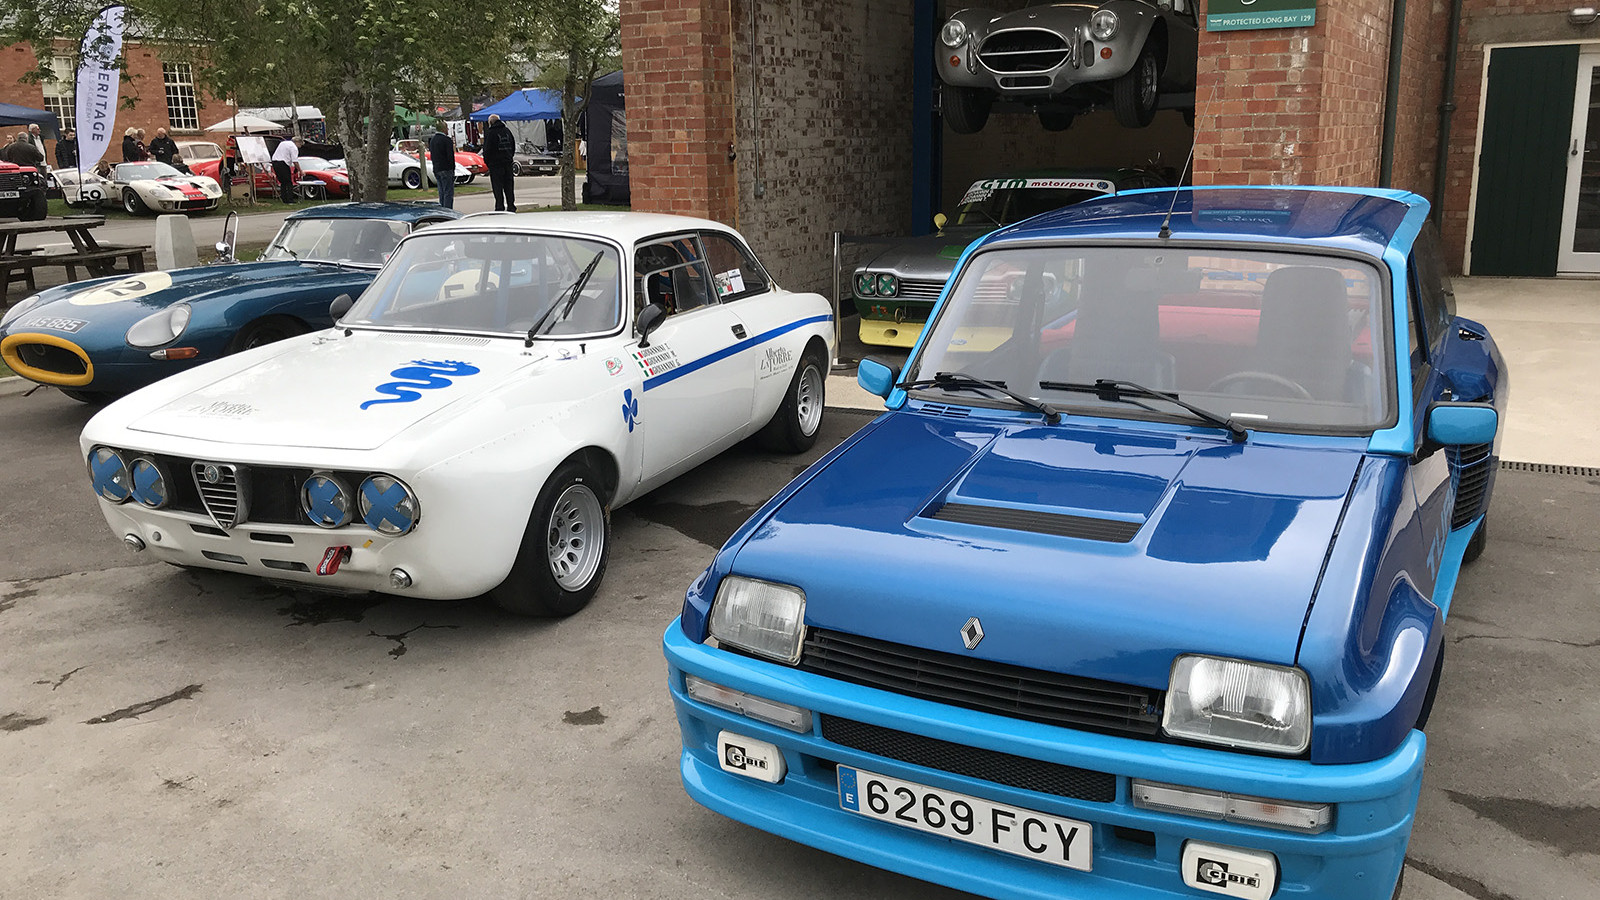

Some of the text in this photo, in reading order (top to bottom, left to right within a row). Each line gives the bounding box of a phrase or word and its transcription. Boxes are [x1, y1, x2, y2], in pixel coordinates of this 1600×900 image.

[1222, 17, 1260, 26] PROTECTED
[1262, 16, 1282, 24] LONG
[980, 178, 1094, 190] GTM motorsport
[46, 319, 81, 331] 885
[846, 780, 1079, 861] E 6269 FCY
